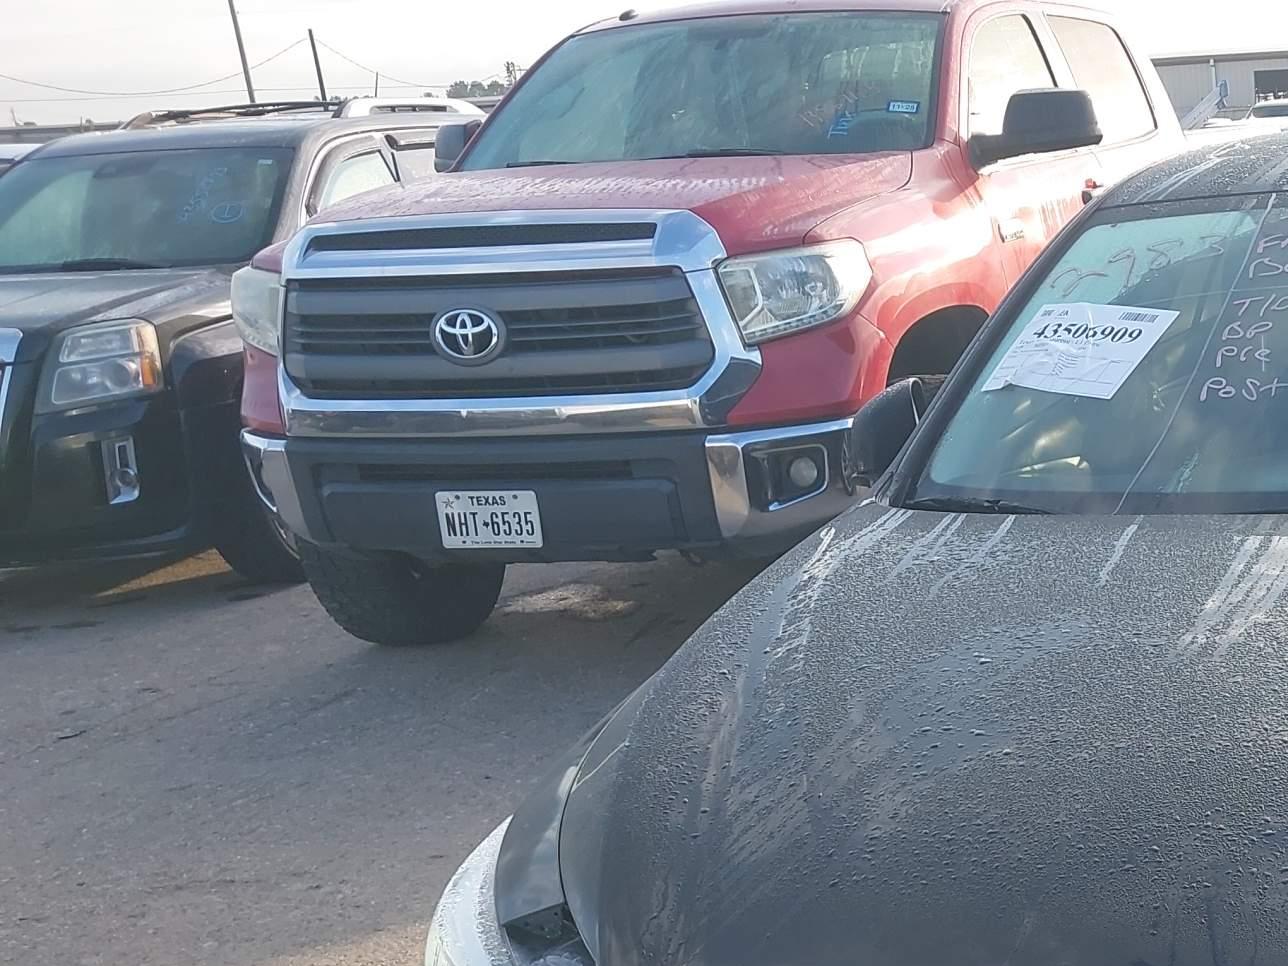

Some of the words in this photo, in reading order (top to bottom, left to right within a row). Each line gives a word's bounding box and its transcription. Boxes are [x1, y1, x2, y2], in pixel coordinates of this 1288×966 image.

[1033, 322, 1143, 344] 43506909
[468, 495, 506, 507] TEXAS
[444, 511, 478, 537] NHT
[490, 511, 535, 537] 6535
